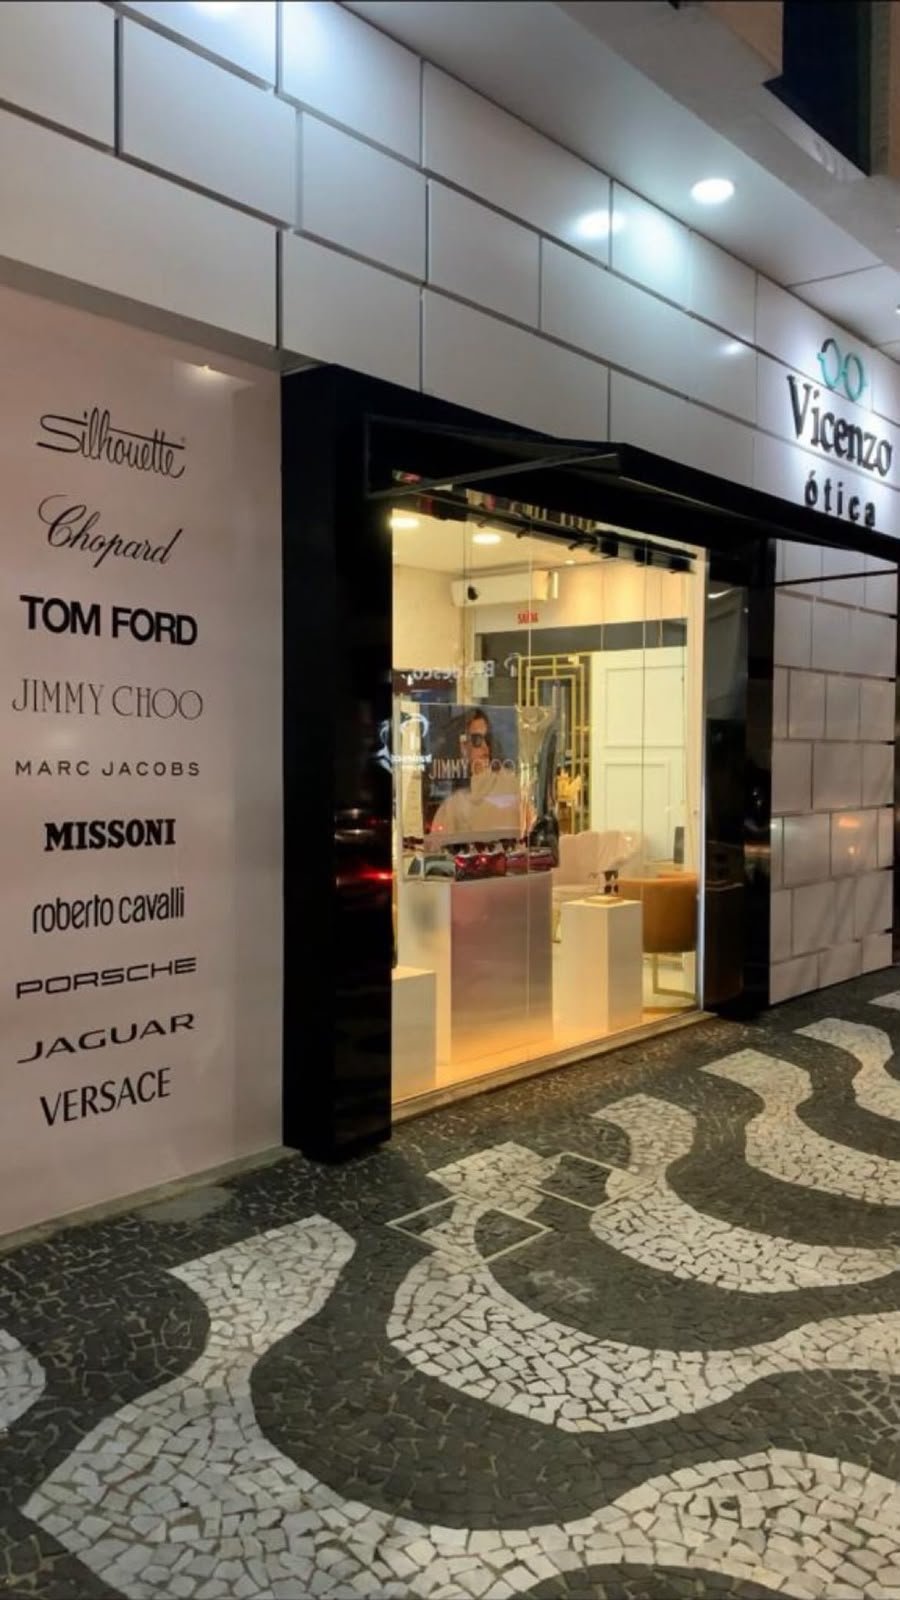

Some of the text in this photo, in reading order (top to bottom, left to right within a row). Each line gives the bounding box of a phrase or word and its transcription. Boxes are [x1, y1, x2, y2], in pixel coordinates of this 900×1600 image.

[786, 374, 893, 477] Vicenzo
[804, 470, 876, 527] ótica
[38, 495, 183, 568] Chopard
[19, 595, 198, 646] TOM FORD
[12, 678, 203, 720] JIMMY CHOO
[15, 760, 200, 776] MARC JACOBS
[428, 758, 469, 780] JIMMY
[44, 818, 176, 852] MISSONI
[32, 886, 184, 934] roberto cavalli
[16, 957, 197, 999] PORSCHE
[17, 1013, 194, 1063] JAGUAR
[40, 1067, 170, 1126] VERSACE
